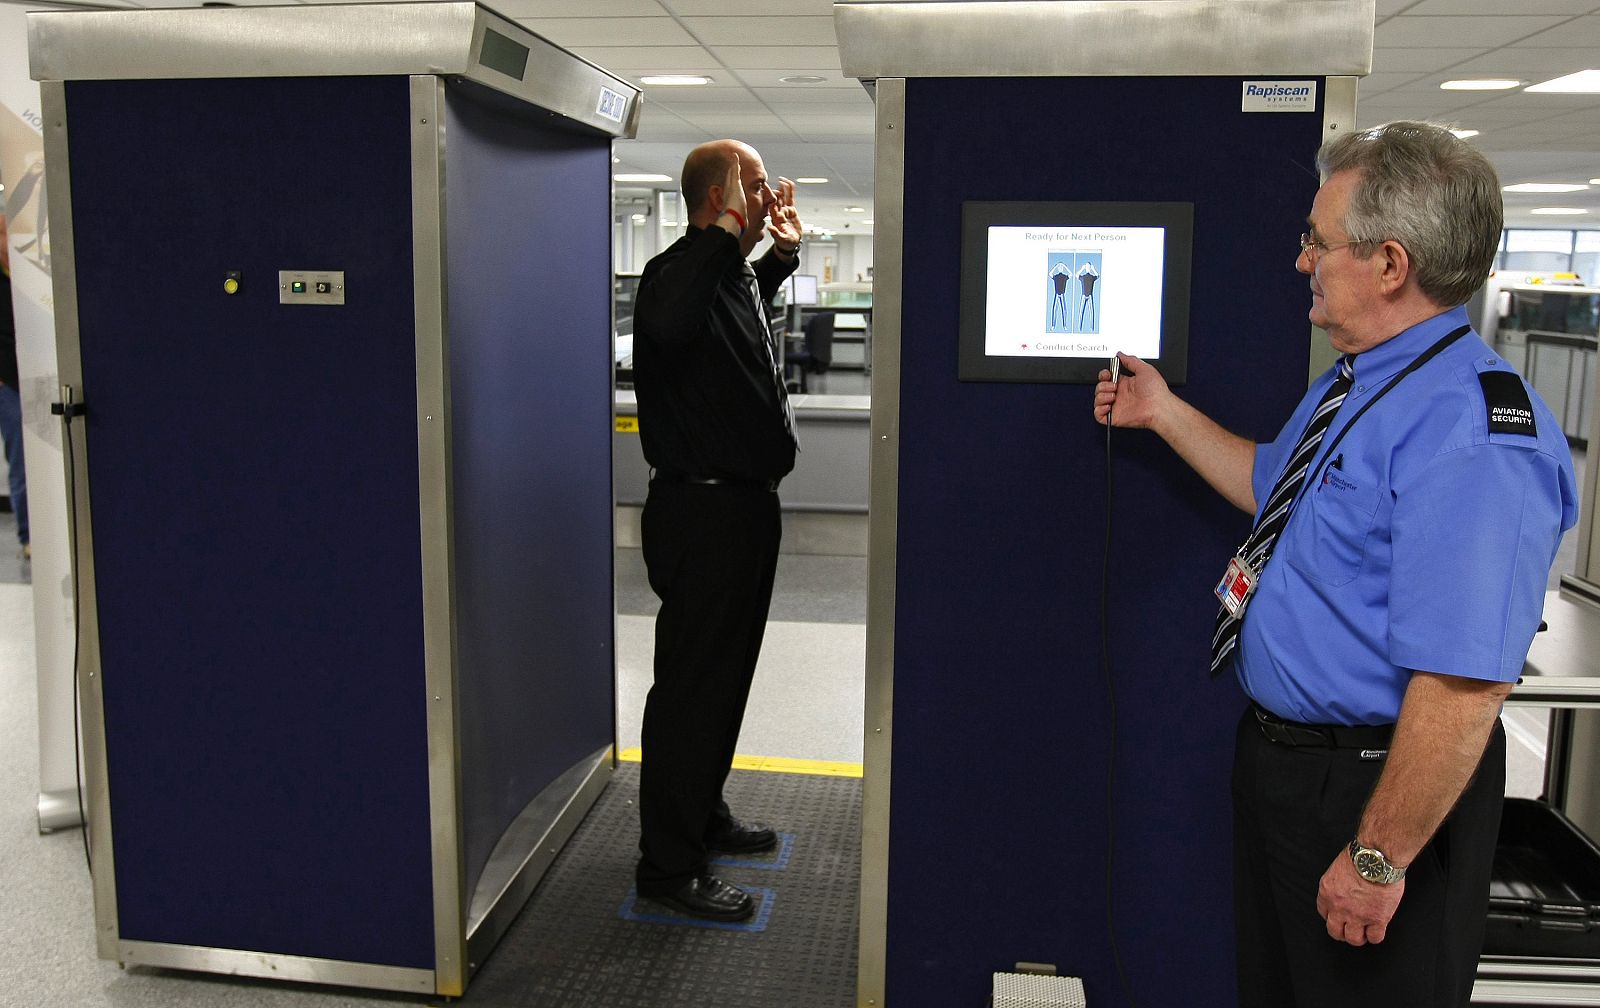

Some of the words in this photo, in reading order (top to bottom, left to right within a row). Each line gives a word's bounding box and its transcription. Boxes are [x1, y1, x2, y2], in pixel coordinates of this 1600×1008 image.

[1246, 84, 1309, 98] Rapiscan
[1025, 232, 1053, 242] Ready
[1056, 232, 1069, 241] for
[1071, 233, 1092, 241] Next
[1094, 233, 1127, 241] Person
[1035, 342, 1074, 352] Conduct
[1076, 342, 1108, 352] Search
[1492, 407, 1531, 418] AVIATION
[1491, 415, 1532, 426] SECURITY
